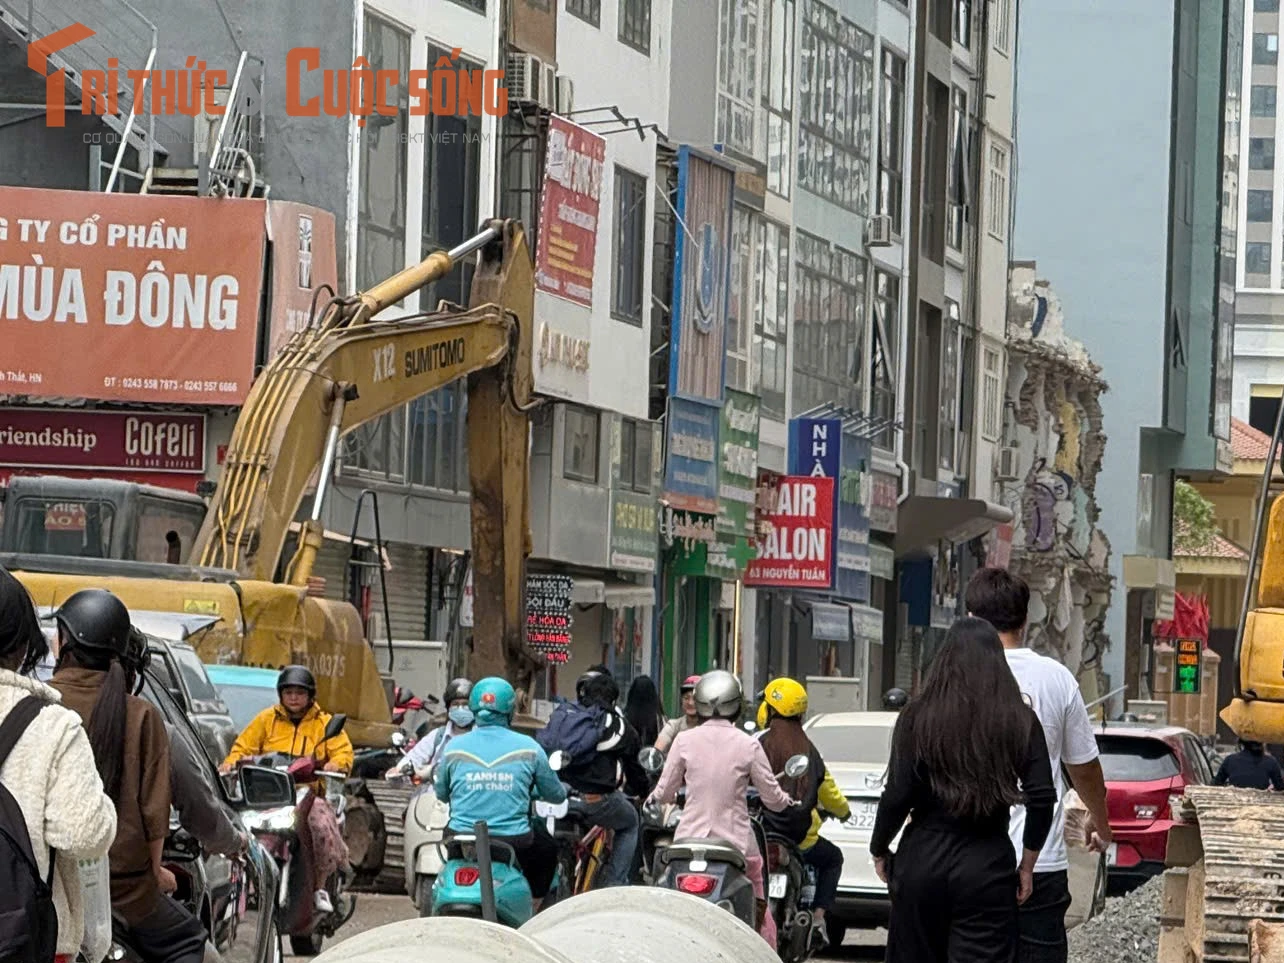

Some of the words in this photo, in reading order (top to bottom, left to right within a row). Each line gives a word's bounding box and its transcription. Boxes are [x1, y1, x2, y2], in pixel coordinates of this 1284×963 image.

[17, 219, 51, 243] TY
[59, 214, 101, 245] CỔ
[107, 218, 187, 250] PHẦN
[104, 260, 239, 330] ĐÔNG
[405, 337, 465, 377] SUMITOMO
[762, 482, 817, 517] AIR
